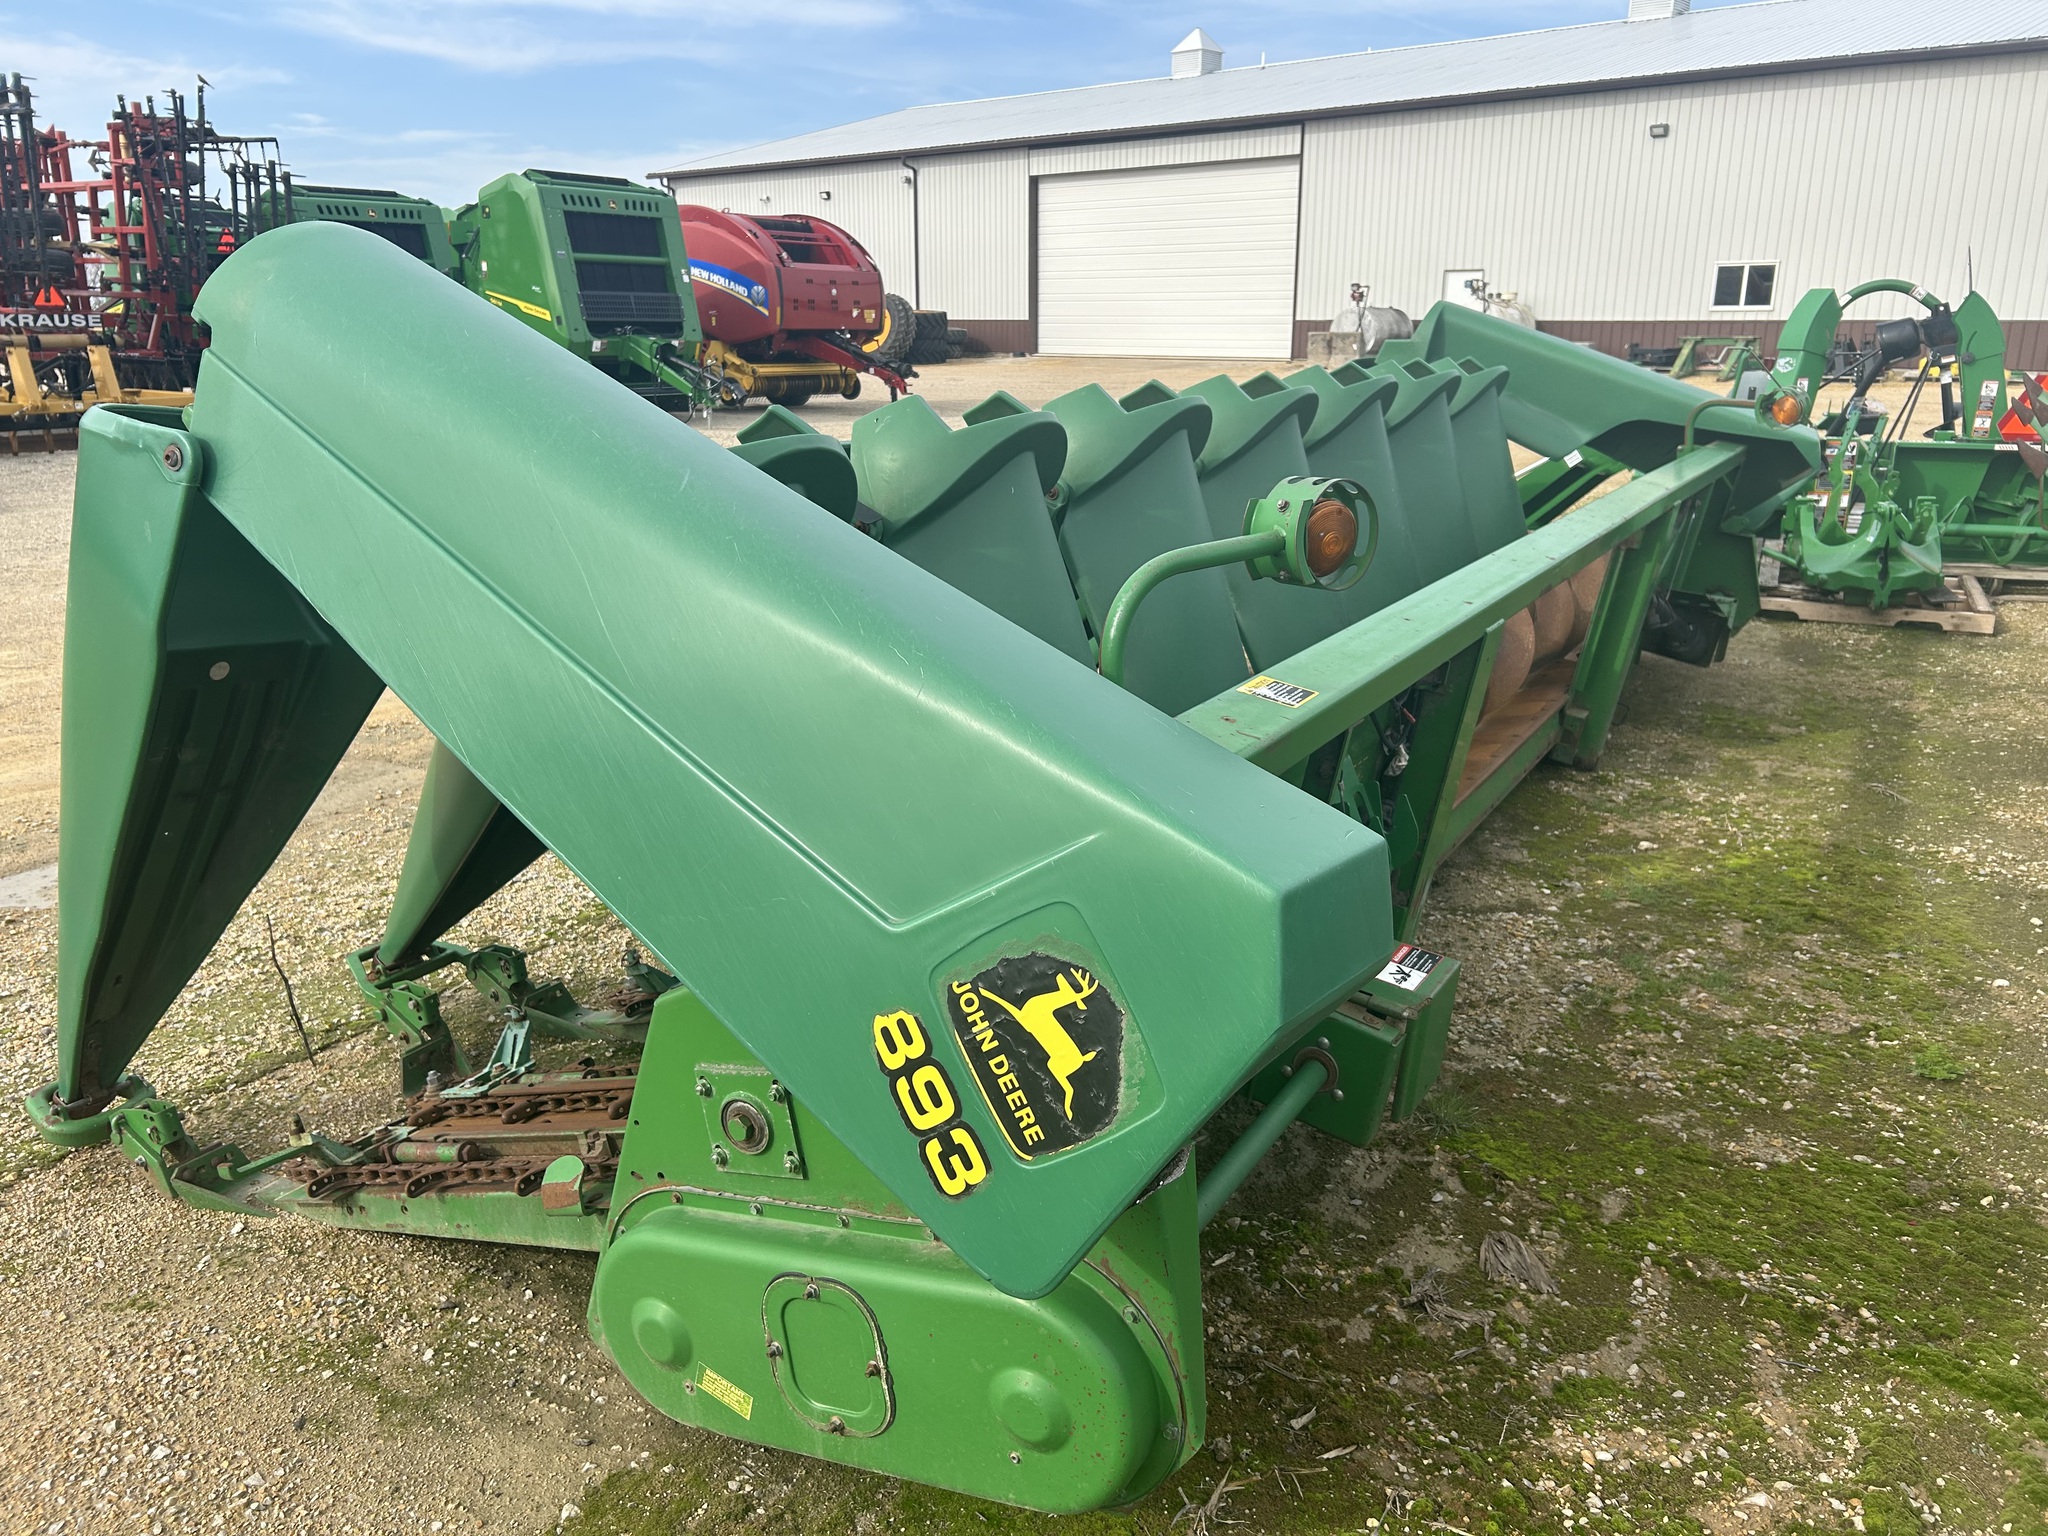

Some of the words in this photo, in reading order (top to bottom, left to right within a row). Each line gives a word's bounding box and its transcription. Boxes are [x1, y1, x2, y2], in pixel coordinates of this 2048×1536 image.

[0, 313, 103, 327] KRAUSE
[690, 266, 709, 280] NEW
[709, 272, 748, 297] HOLLAND
[872, 1009, 988, 1197] 893
[952, 980, 999, 1053] JOHN
[988, 1053, 1046, 1147] DEERE
